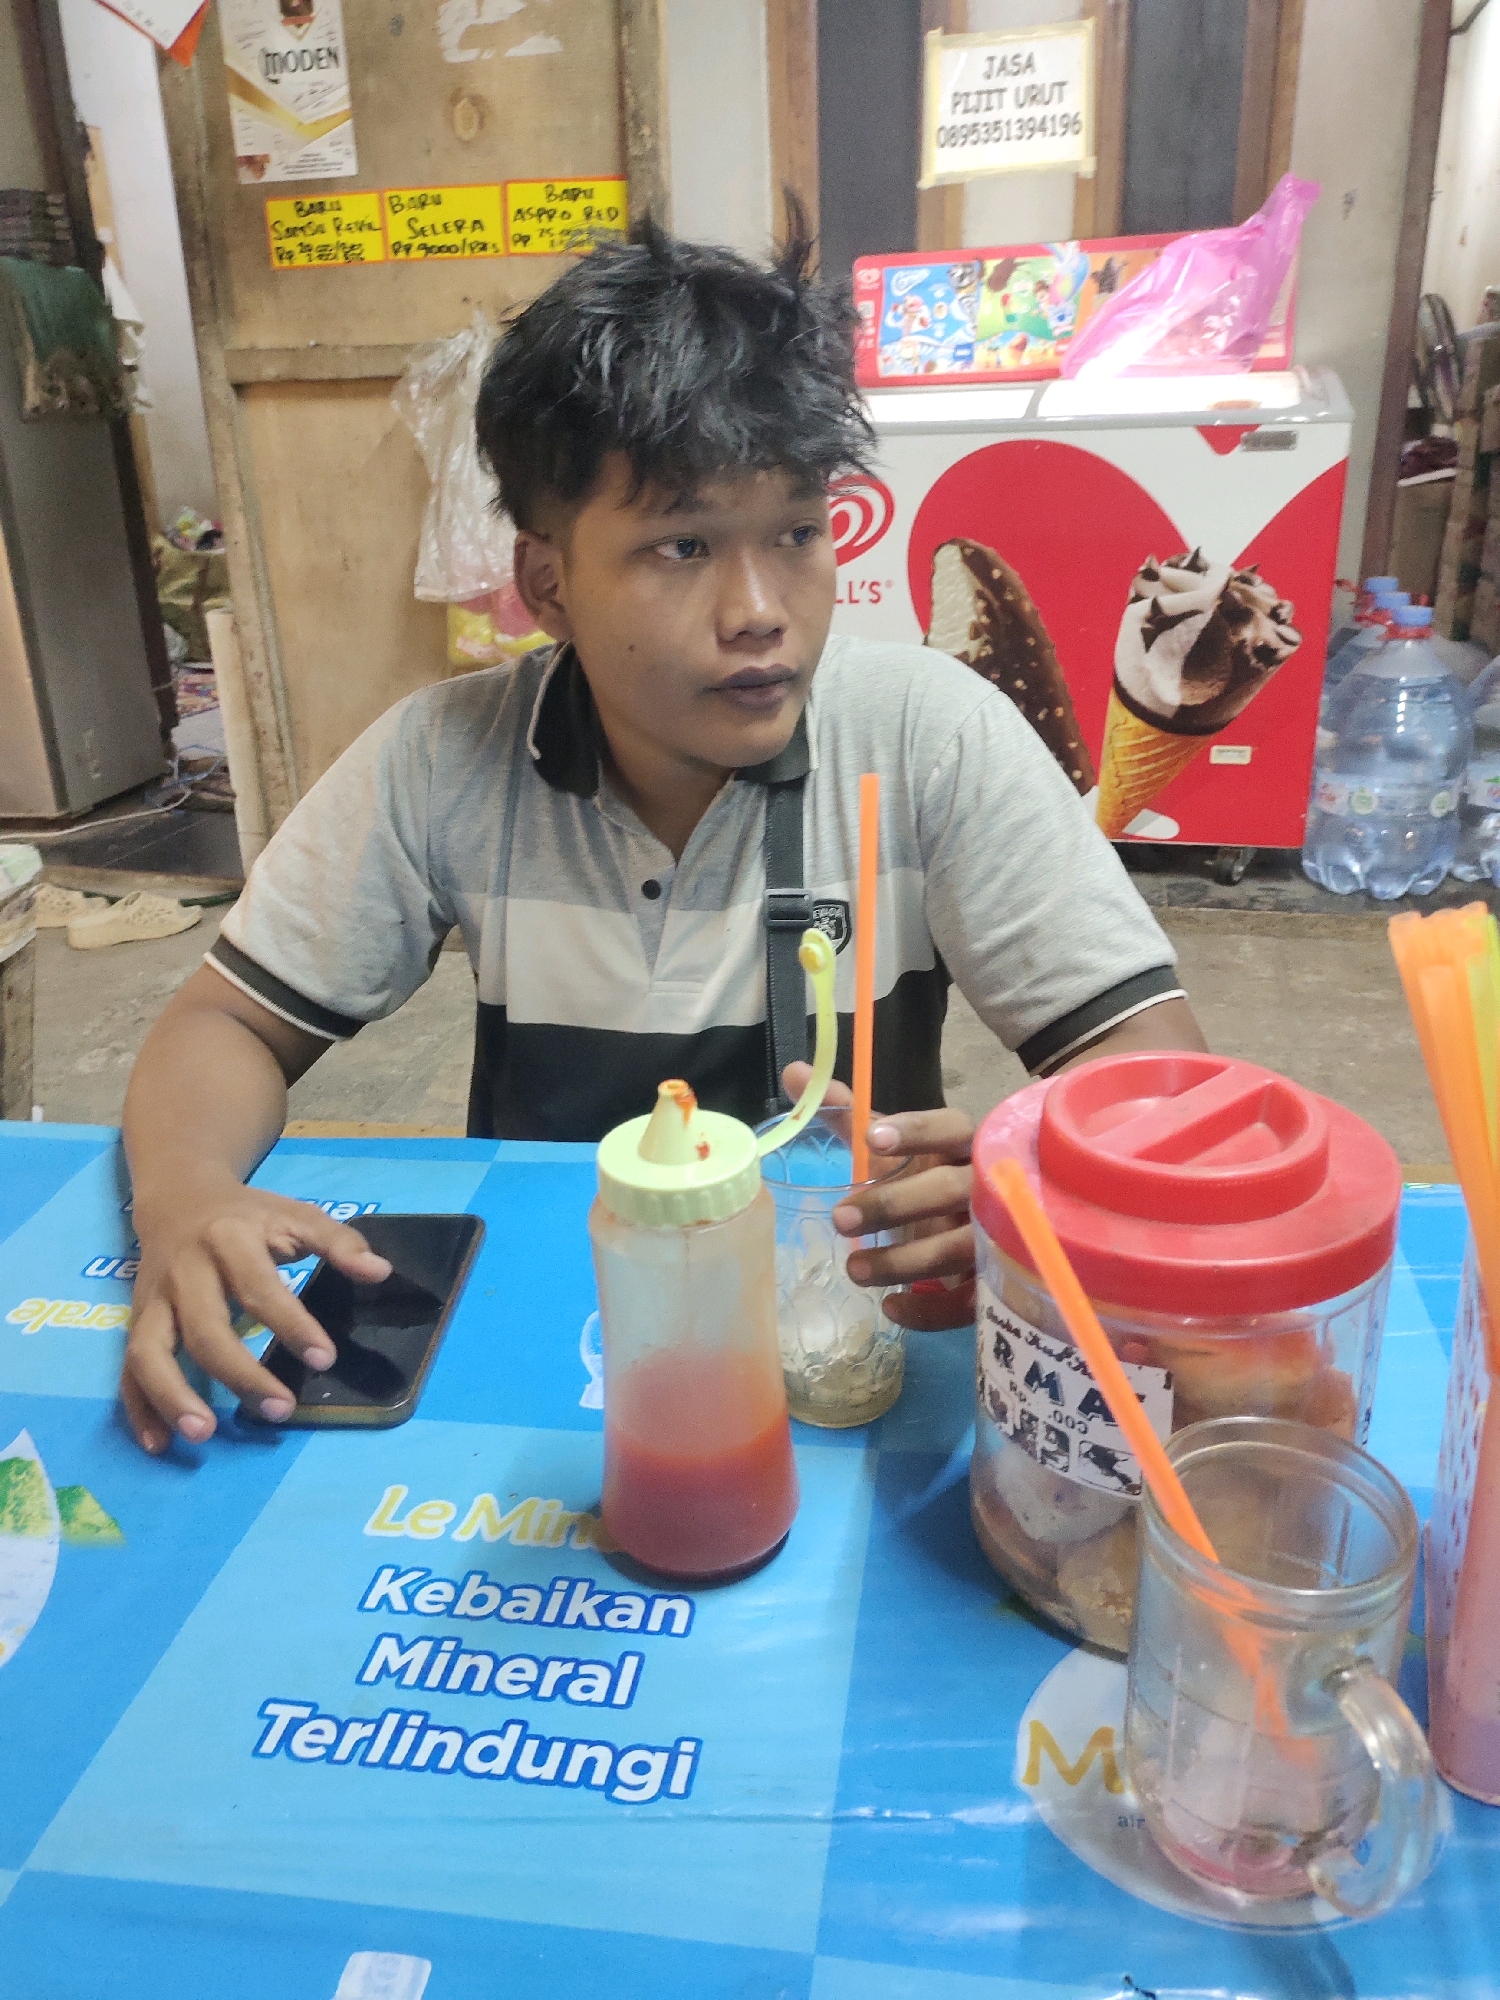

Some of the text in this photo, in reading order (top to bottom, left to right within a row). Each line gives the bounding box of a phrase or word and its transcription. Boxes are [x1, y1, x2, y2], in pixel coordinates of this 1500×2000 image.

[951, 80, 1069, 115] PIJIT URUT
[982, 51, 1037, 80] JASA
[936, 111, 1083, 148] 0895351394196
[364, 1484, 602, 1550] Le Min
[361, 1565, 694, 1637] Kebaikan
[358, 1634, 646, 1707] Mineral
[253, 1699, 701, 1803] Terlindungi
[1022, 1719, 1126, 1795] M
